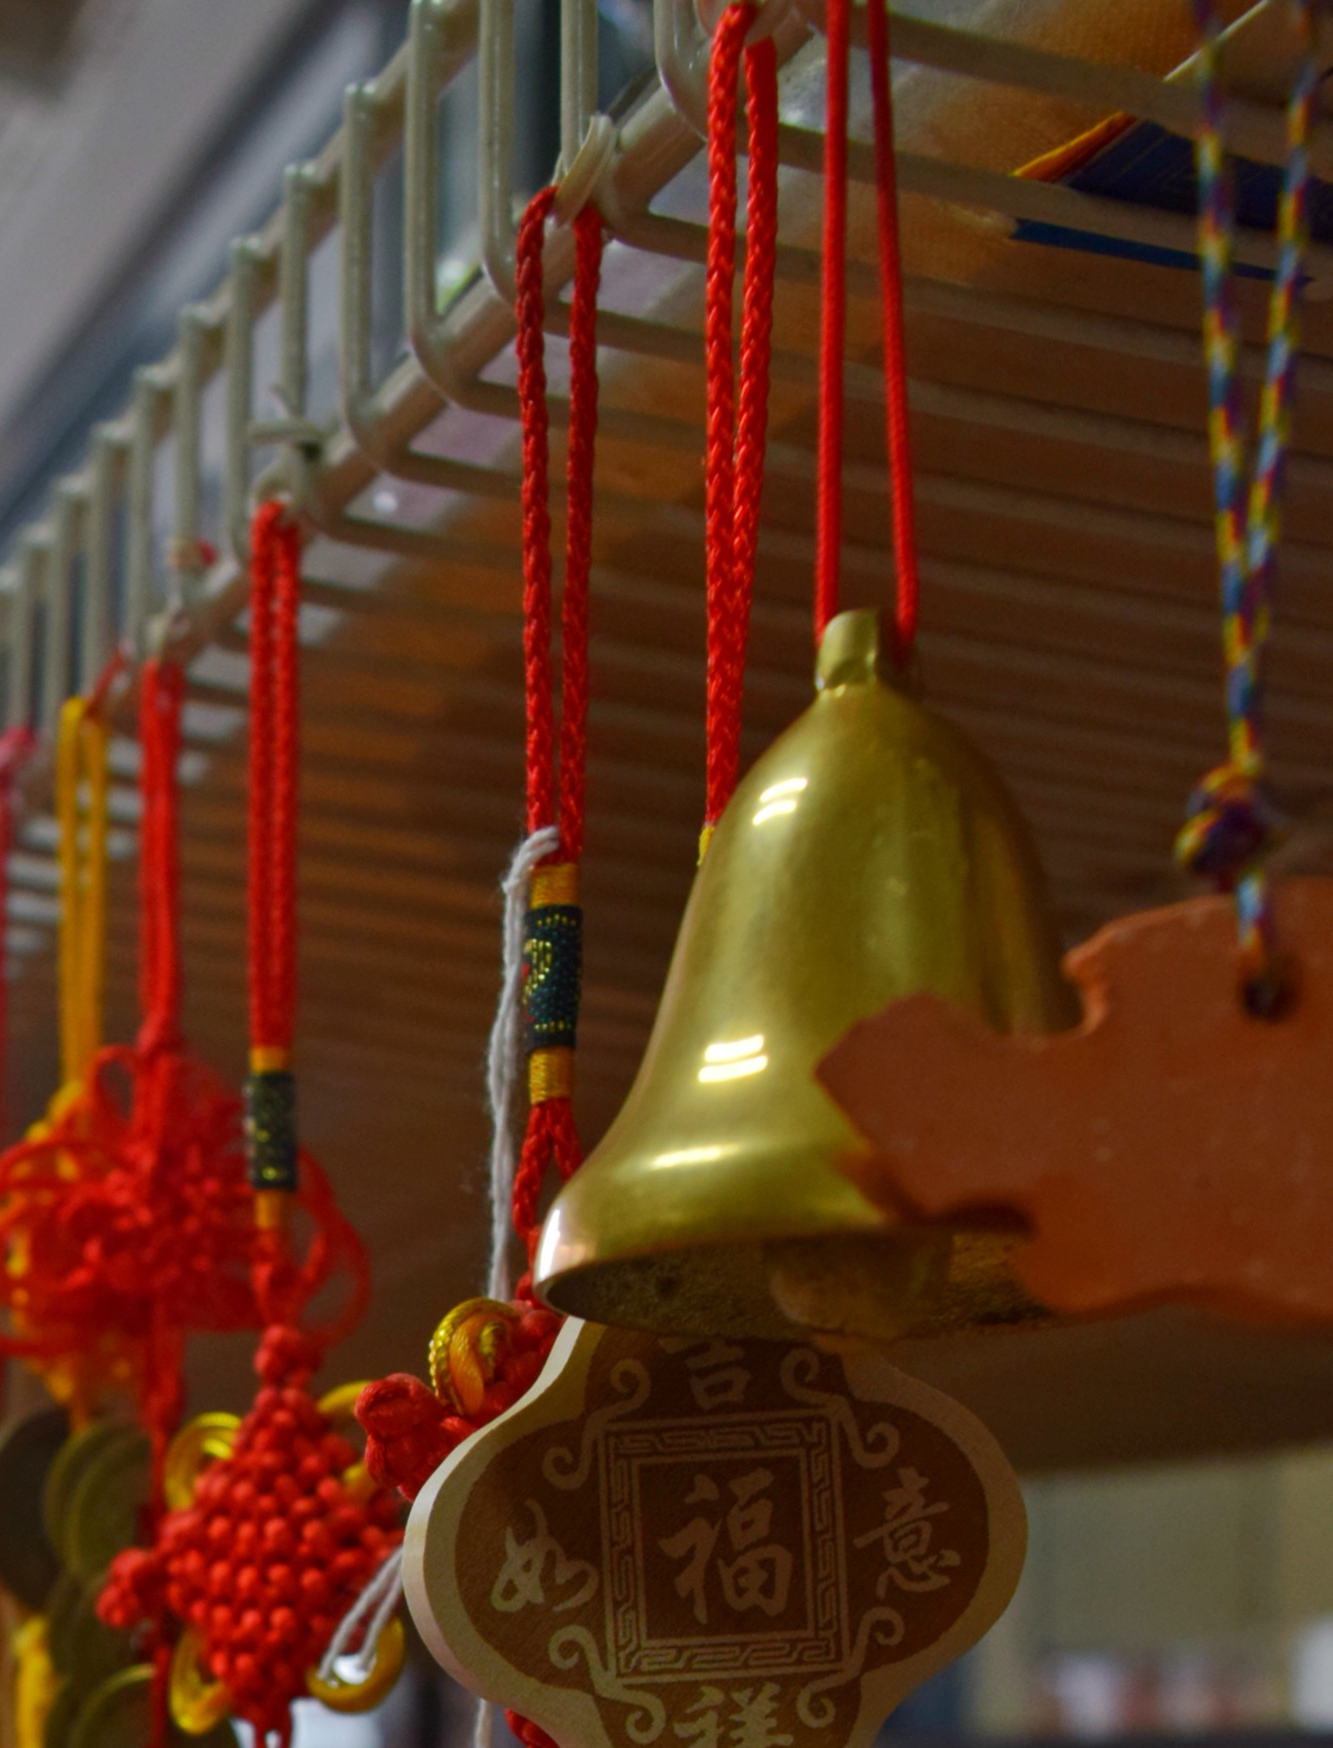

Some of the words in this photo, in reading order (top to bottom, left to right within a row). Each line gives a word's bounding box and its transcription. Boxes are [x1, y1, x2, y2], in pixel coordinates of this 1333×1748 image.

[490, 1500, 599, 1612] 如
[660, 1468, 792, 1624] 福
[853, 1467, 962, 1599] 意
